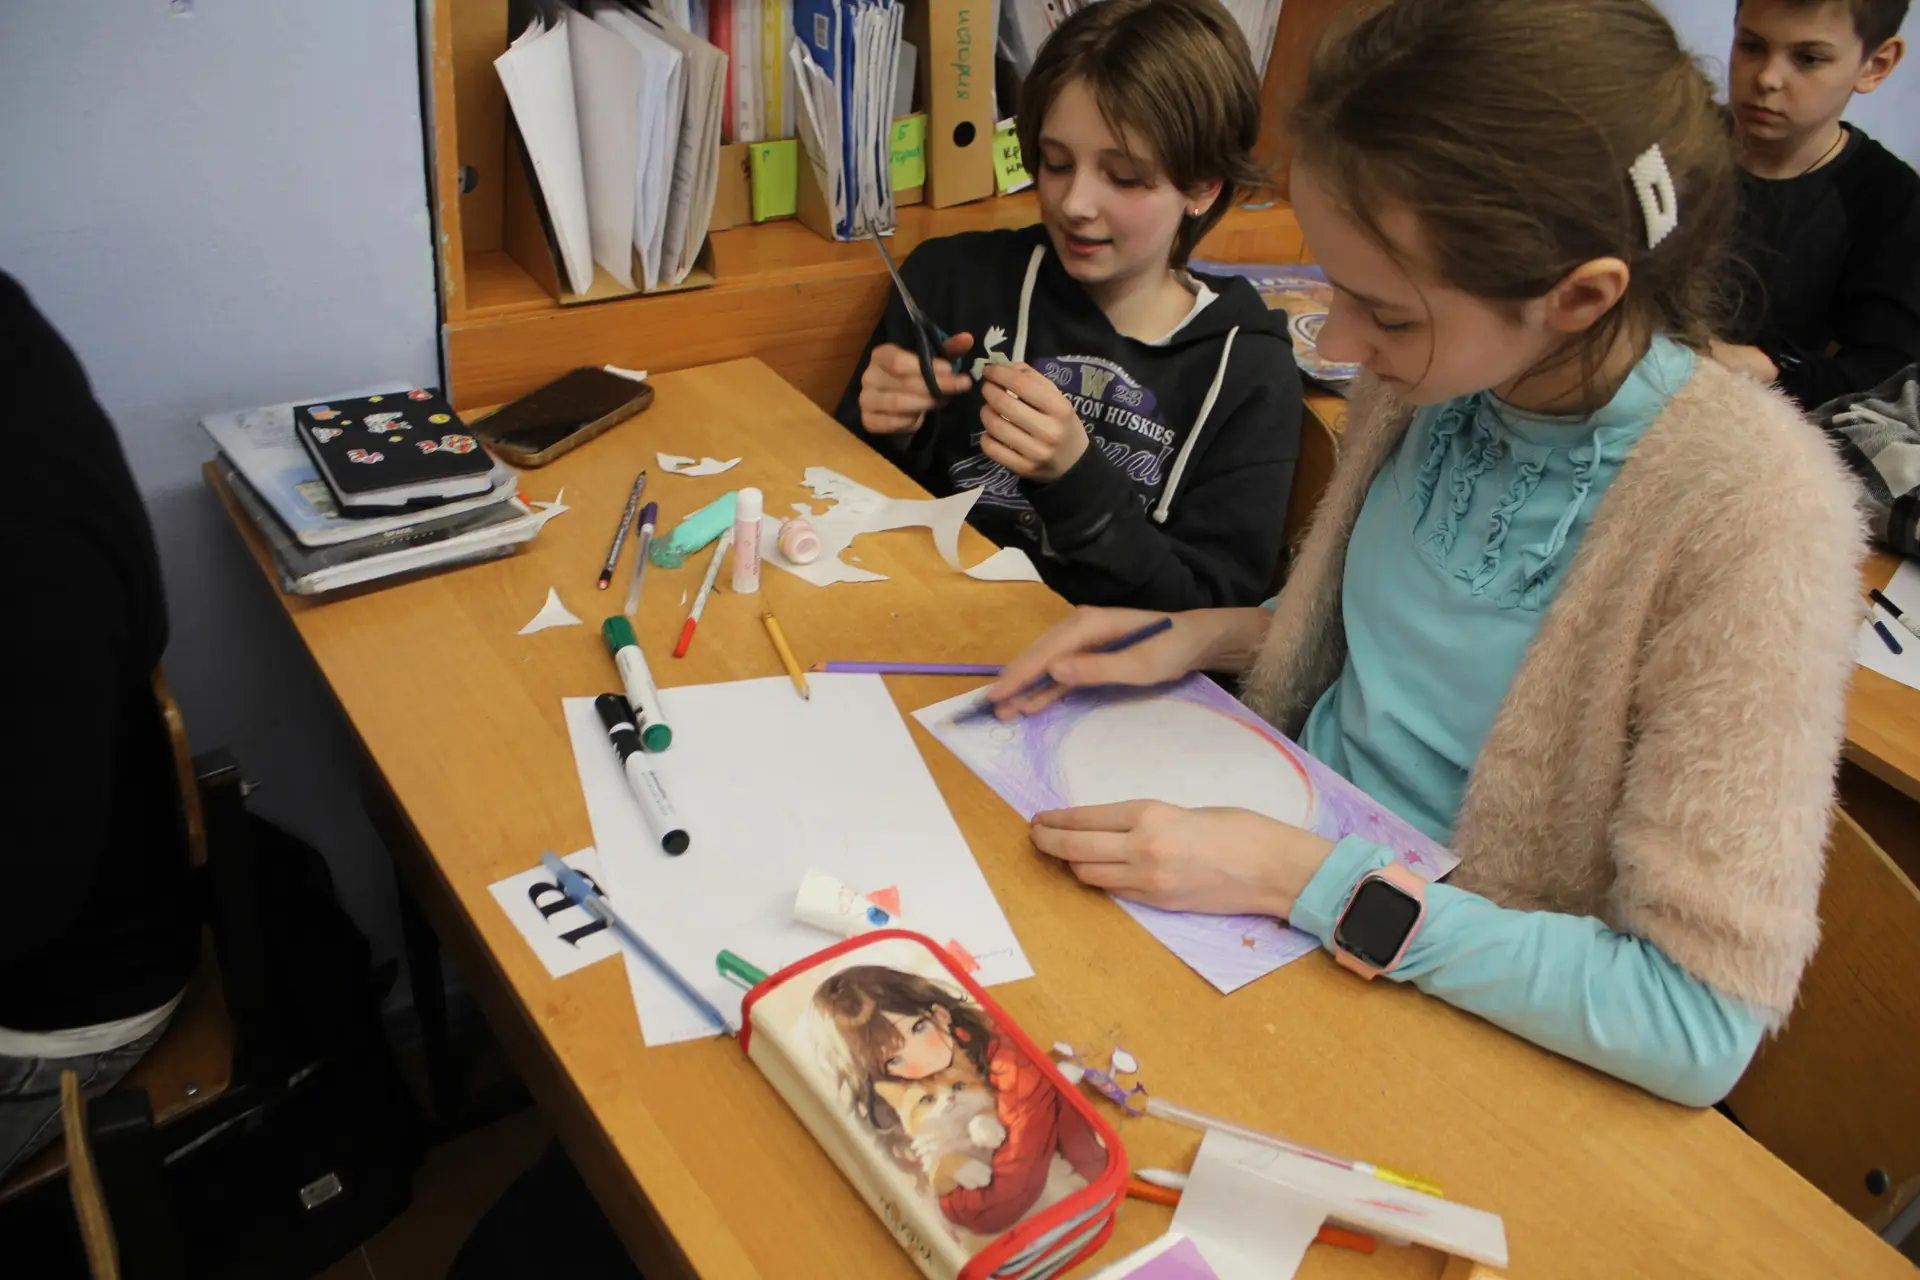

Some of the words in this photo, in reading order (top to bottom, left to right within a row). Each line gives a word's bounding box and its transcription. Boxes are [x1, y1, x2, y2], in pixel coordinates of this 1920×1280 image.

[1043, 361, 1073, 386] 20
[1080, 363, 1115, 400] W
[1104, 405, 1176, 446] HUSKIES
